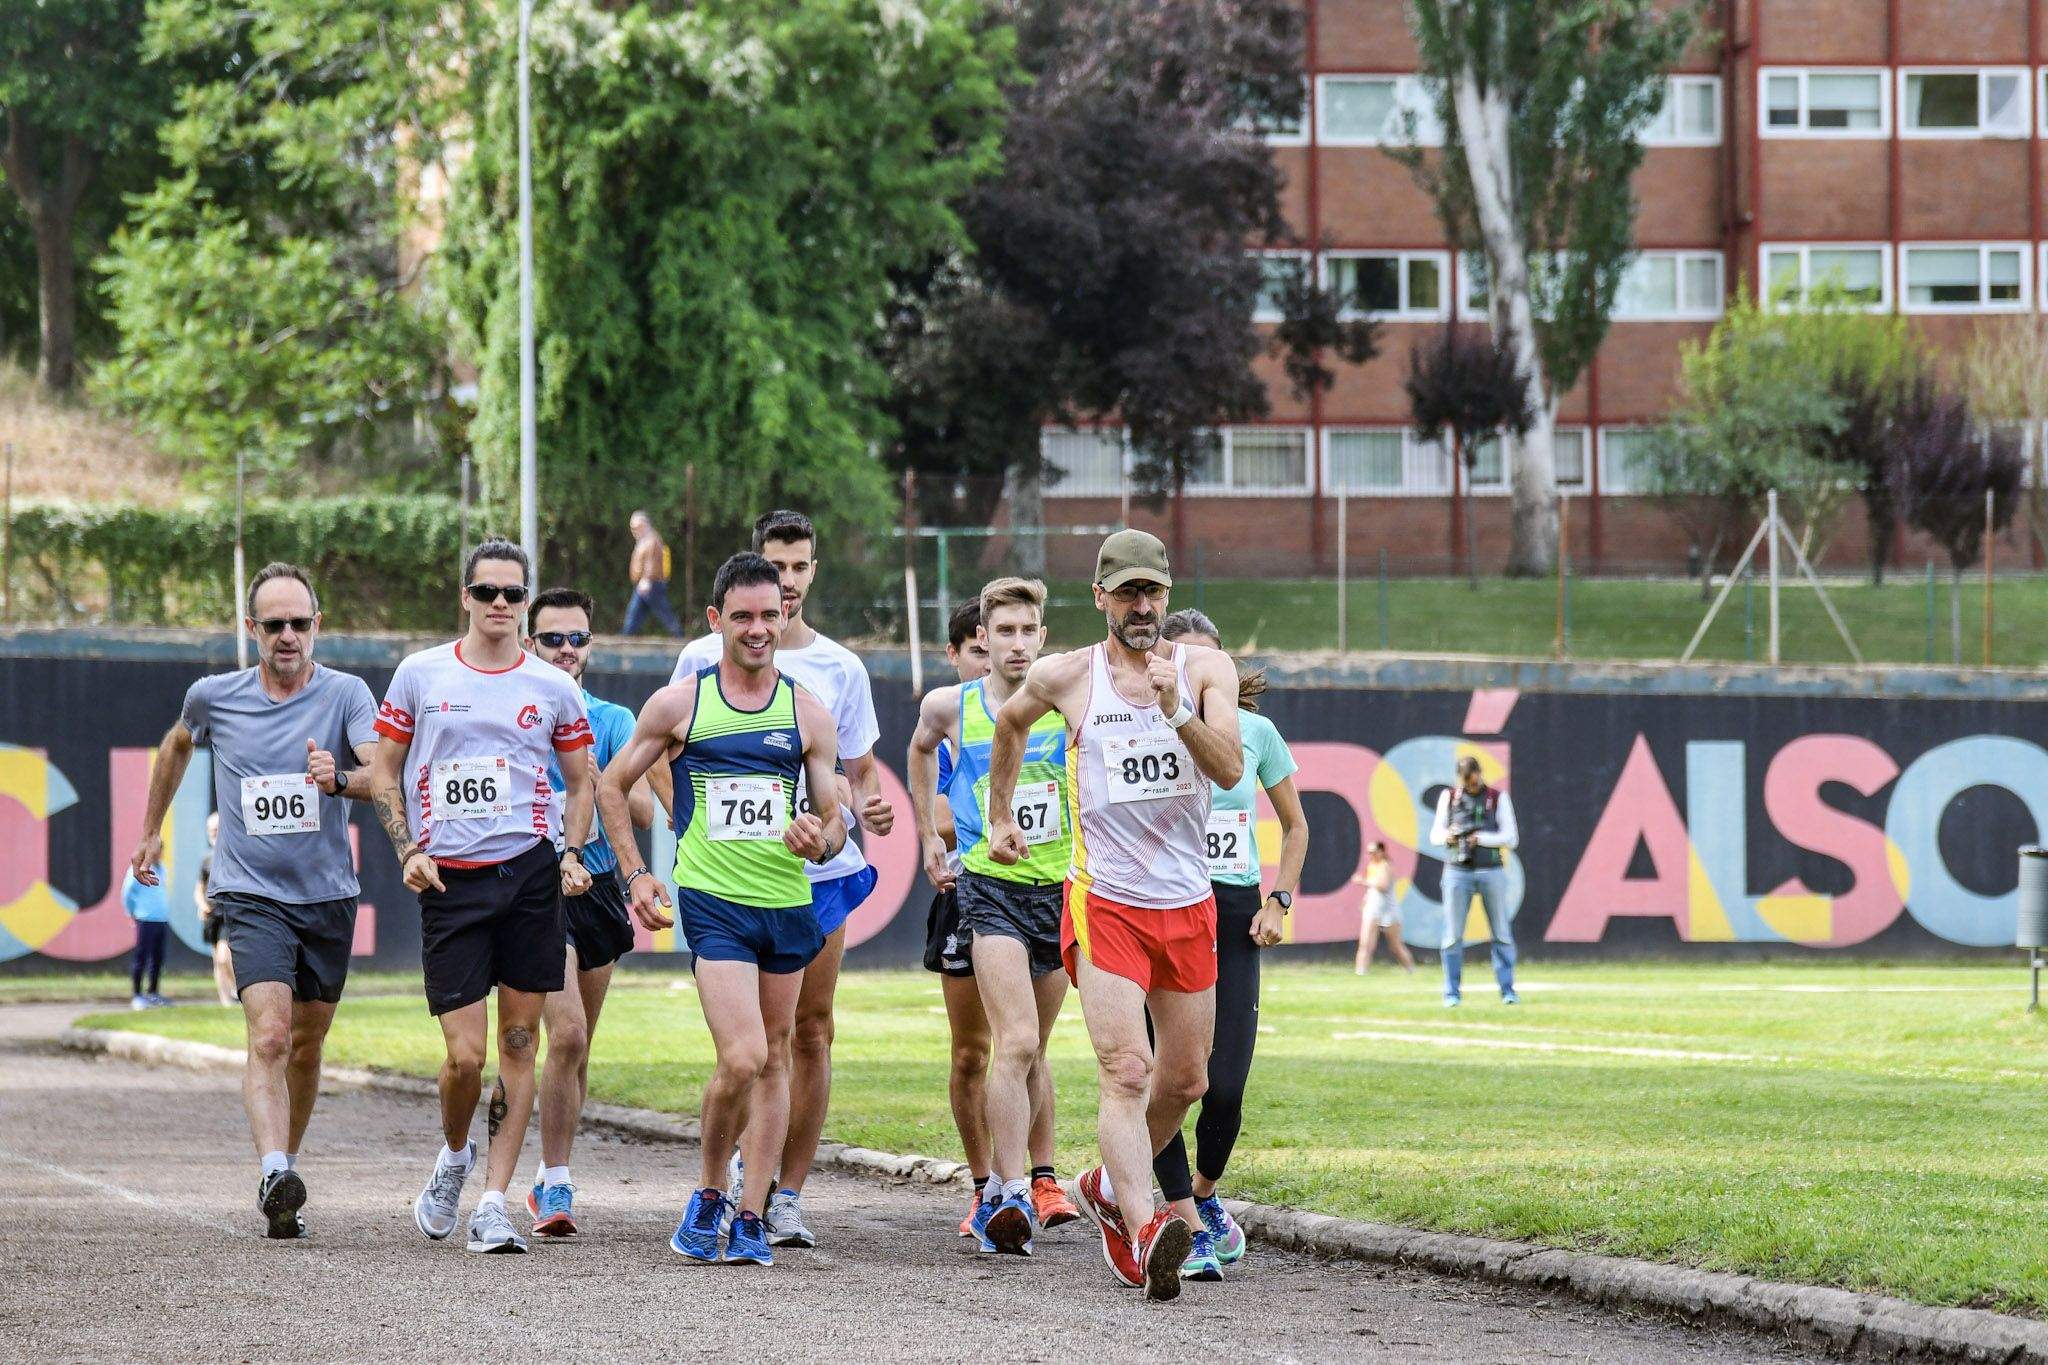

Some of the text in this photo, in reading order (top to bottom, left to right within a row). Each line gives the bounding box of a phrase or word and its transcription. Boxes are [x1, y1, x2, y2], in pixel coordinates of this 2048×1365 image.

[1121, 751, 1179, 785] 803
[445, 777, 497, 805] 866
[1176, 783, 1192, 791] 2023
[254, 794, 305, 821] 906
[721, 799, 773, 826] 764
[1011, 802, 1048, 831] 67
[1047, 829, 1058, 838] 2023
